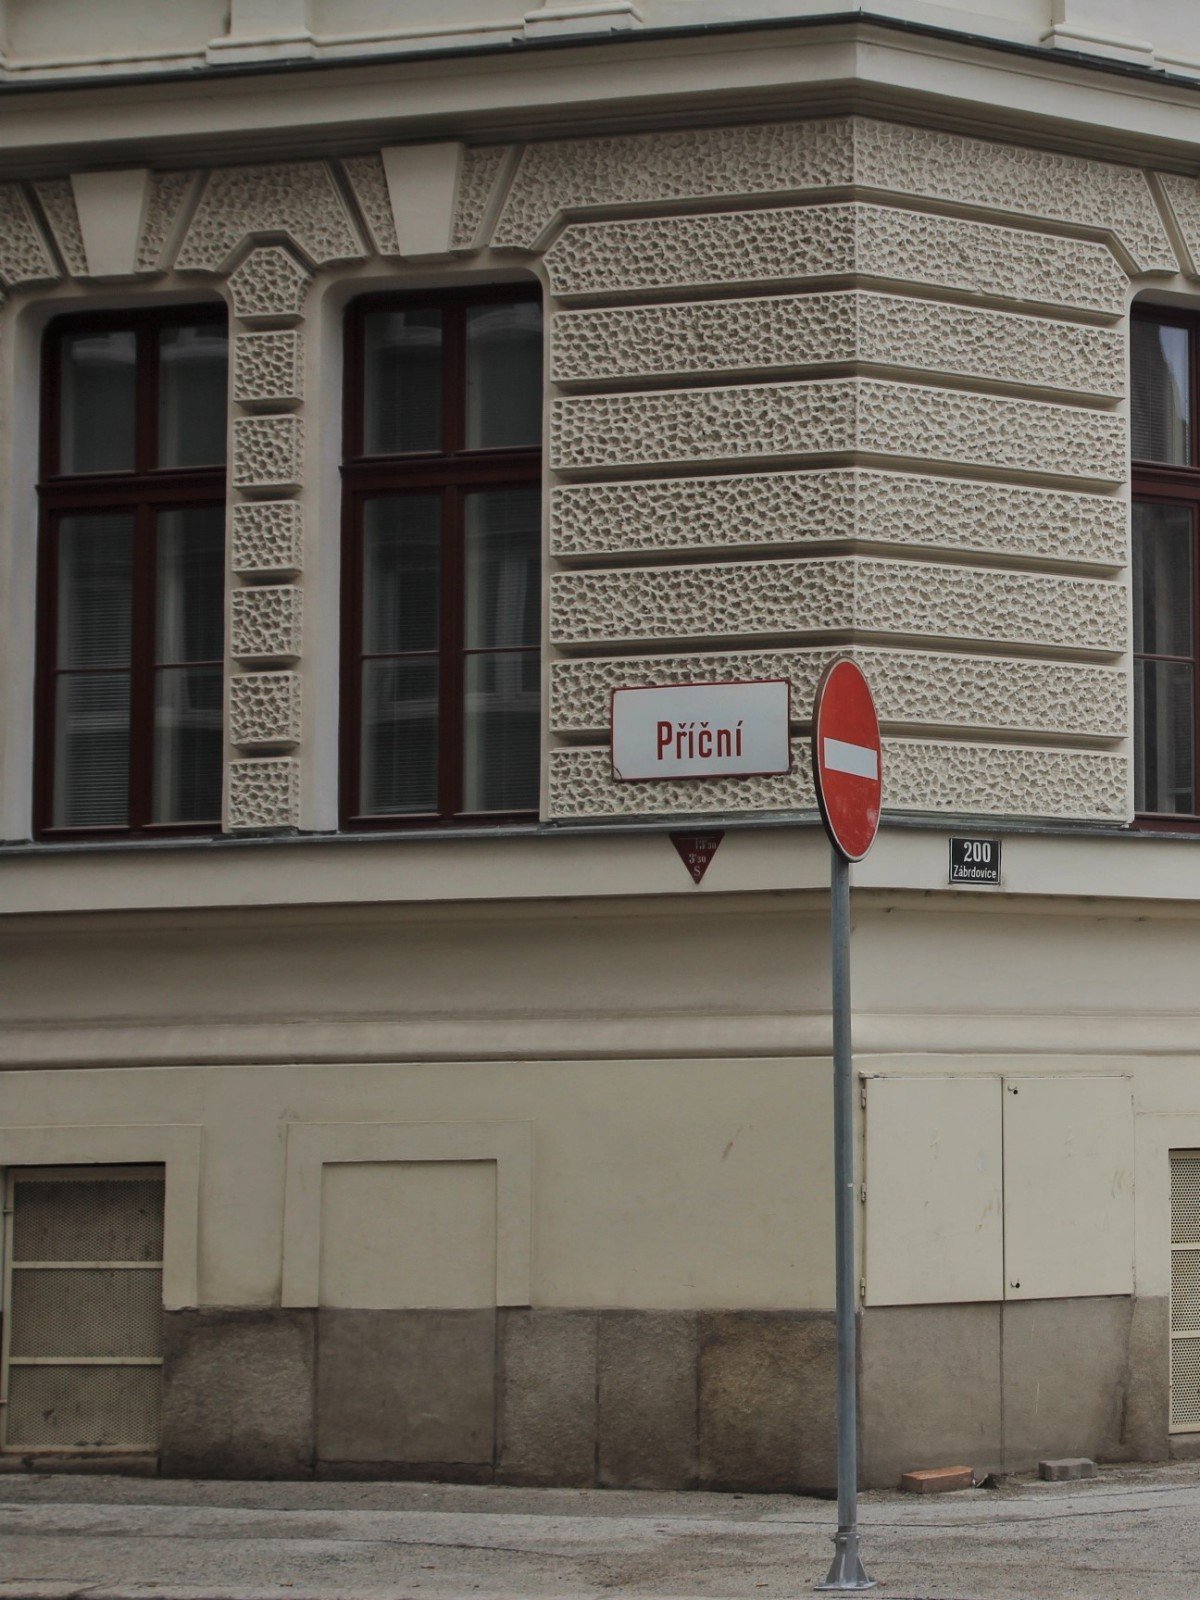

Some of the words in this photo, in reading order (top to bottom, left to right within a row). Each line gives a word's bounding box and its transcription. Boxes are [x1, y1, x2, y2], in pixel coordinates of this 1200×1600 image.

[657, 720, 743, 760] Příční
[963, 841, 991, 863] 200
[953, 865, 997, 879] Zábrdovice
